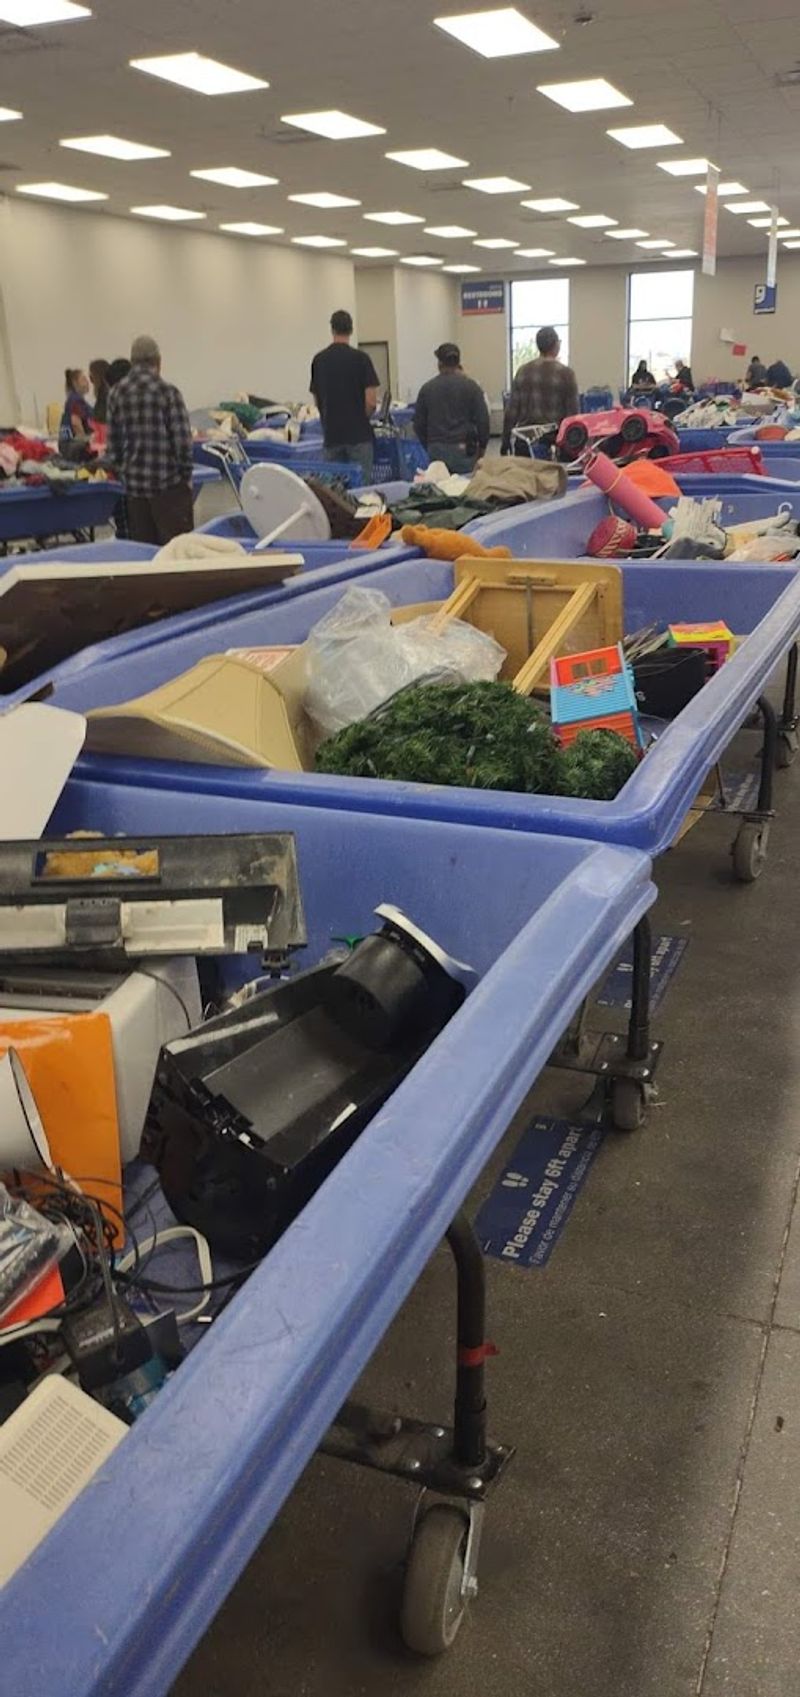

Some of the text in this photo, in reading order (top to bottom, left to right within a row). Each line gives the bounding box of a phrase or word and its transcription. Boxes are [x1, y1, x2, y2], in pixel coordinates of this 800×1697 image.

[502, 1126, 584, 1258] Please stay 6ft apart
